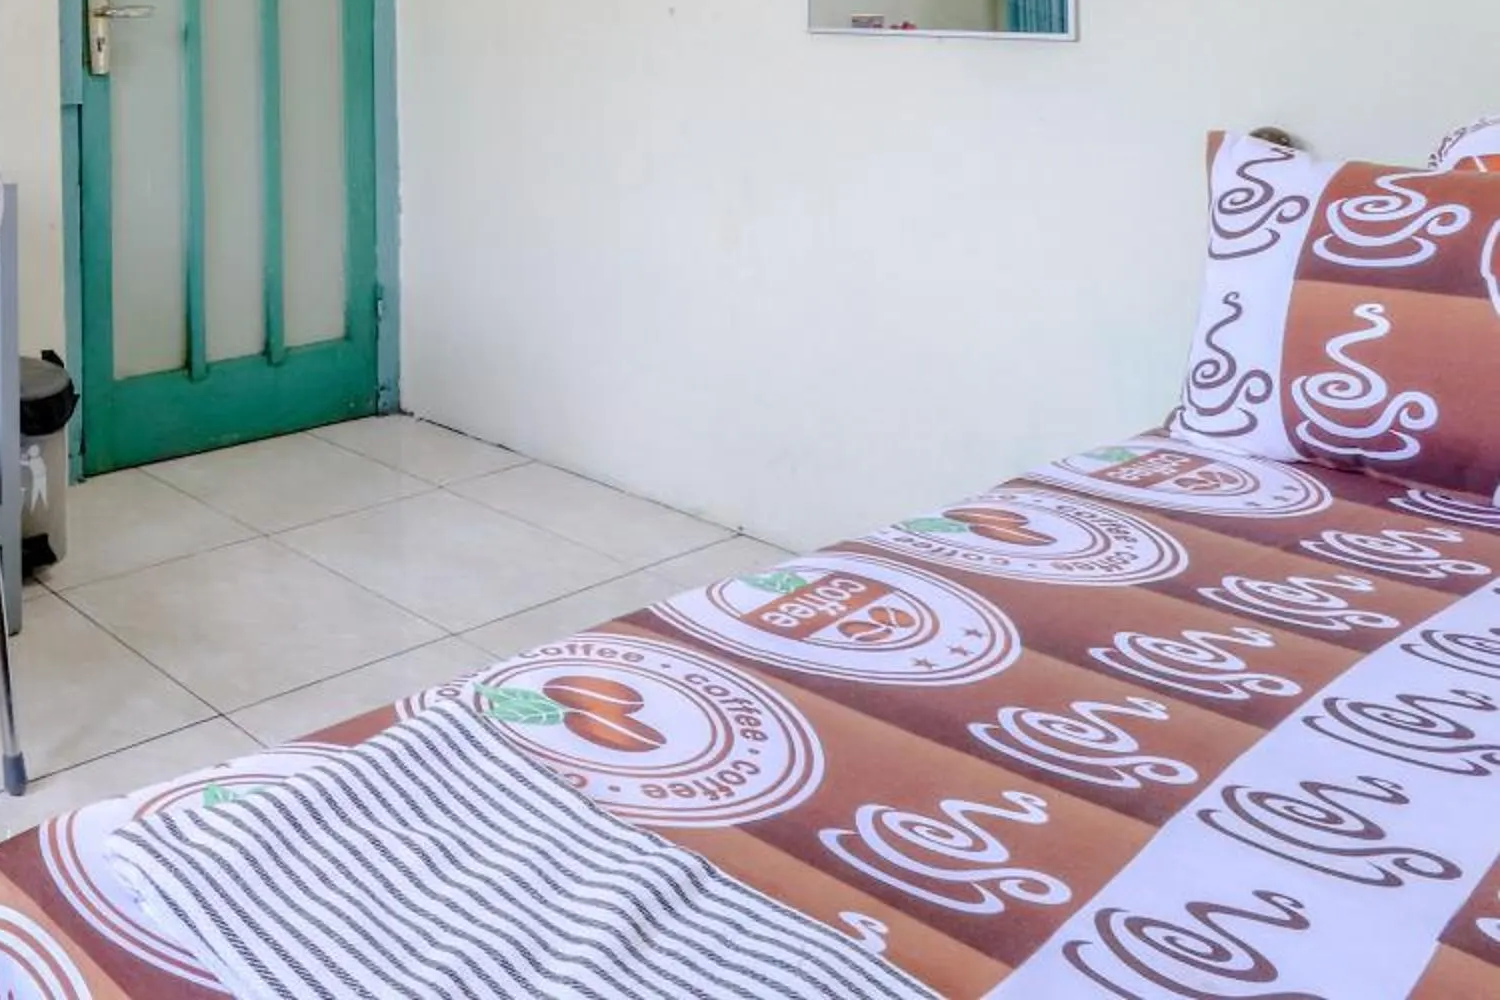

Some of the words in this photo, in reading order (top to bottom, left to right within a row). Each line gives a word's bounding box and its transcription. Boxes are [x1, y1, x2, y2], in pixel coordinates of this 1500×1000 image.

[761, 578, 868, 628] coffee
[518, 642, 646, 664] coffee
[683, 672, 769, 742] coffee
[640, 758, 761, 801] coffee
